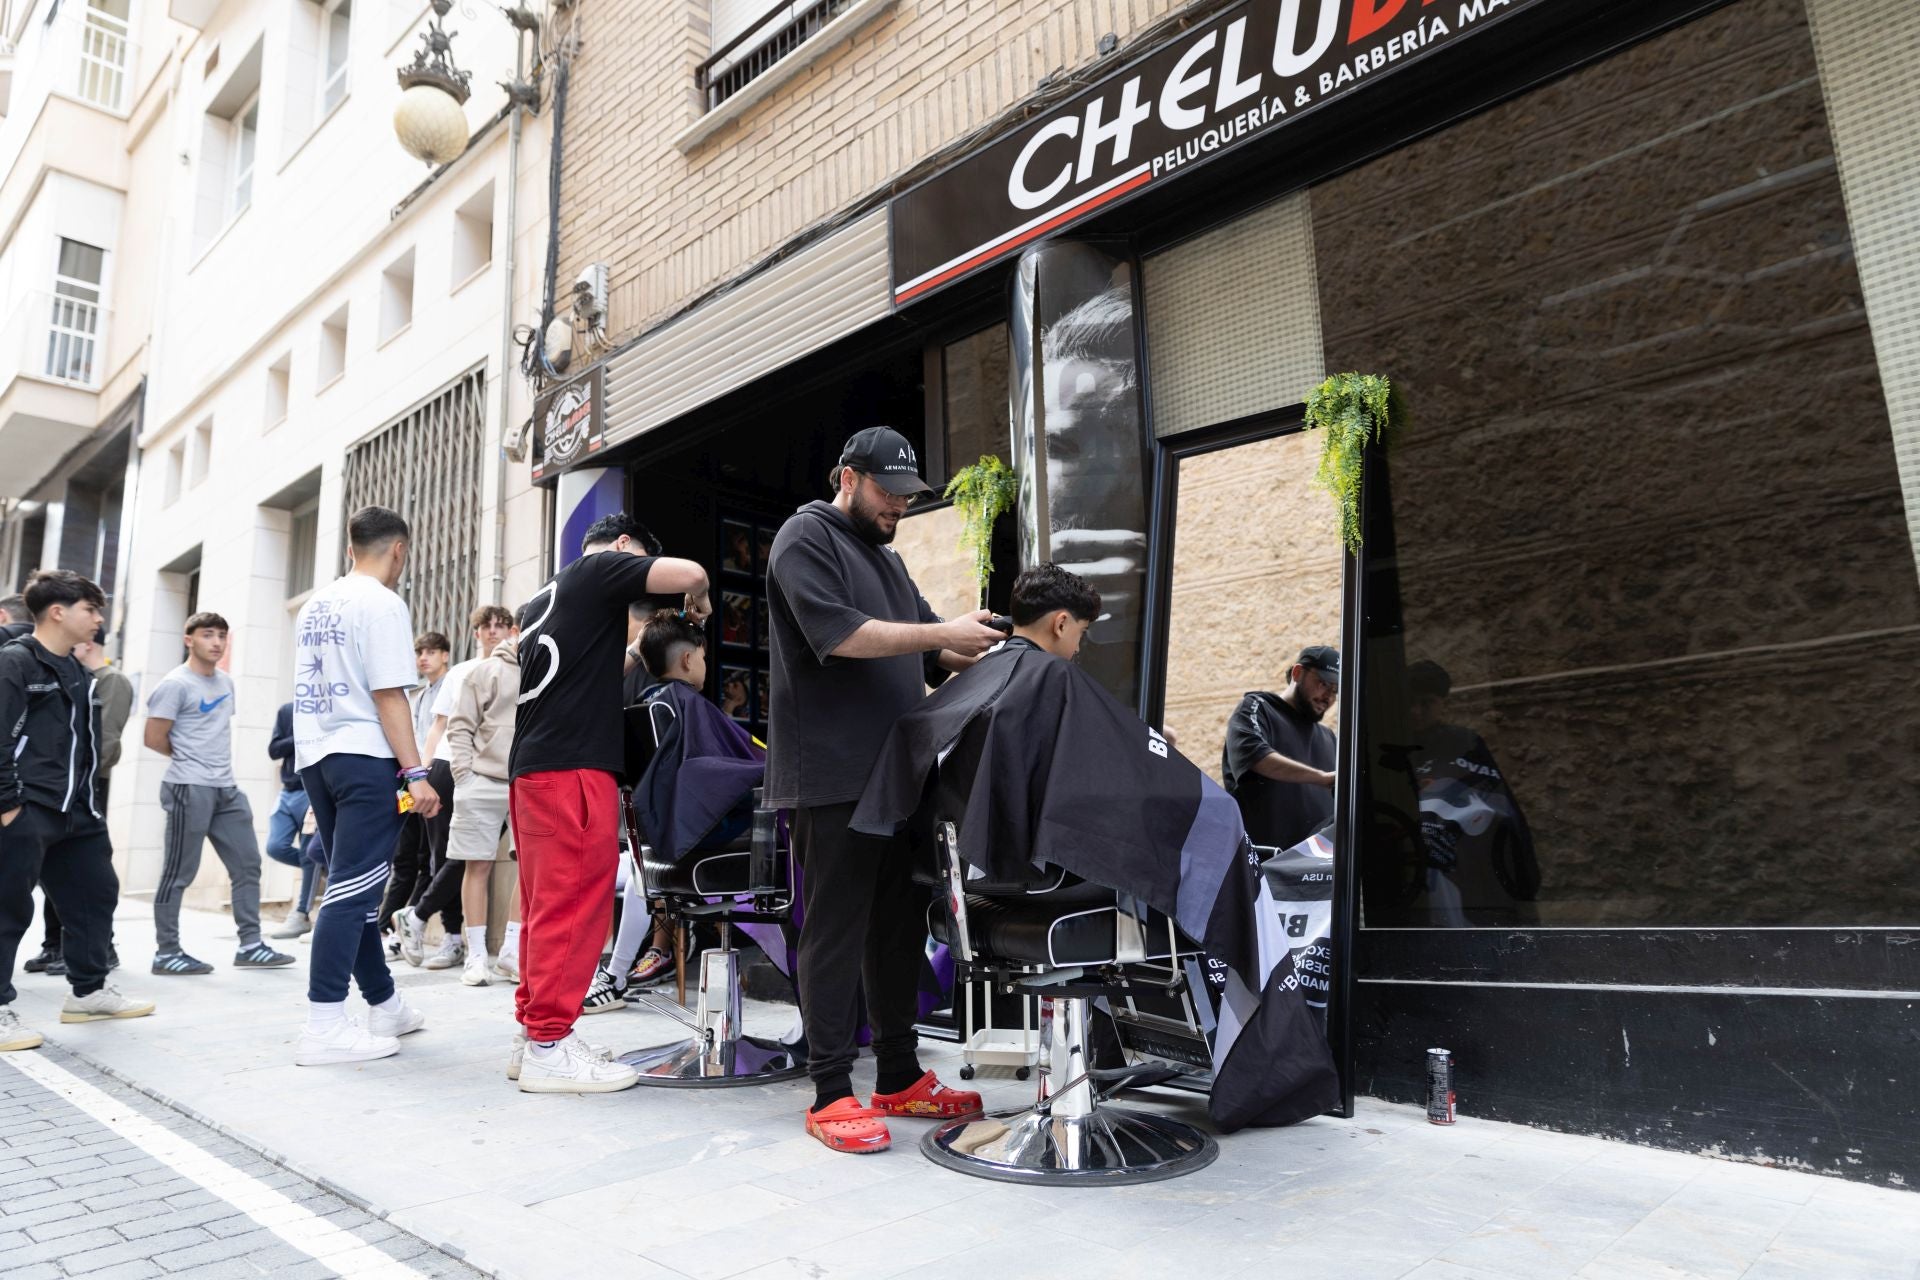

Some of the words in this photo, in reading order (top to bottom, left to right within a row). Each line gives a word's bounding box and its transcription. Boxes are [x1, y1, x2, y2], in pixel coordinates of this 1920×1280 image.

[1153, 96, 1288, 178] PELUQUERÍA
[1294, 85, 1312, 107] &
[1318, 16, 1450, 95] BARBERÍA
